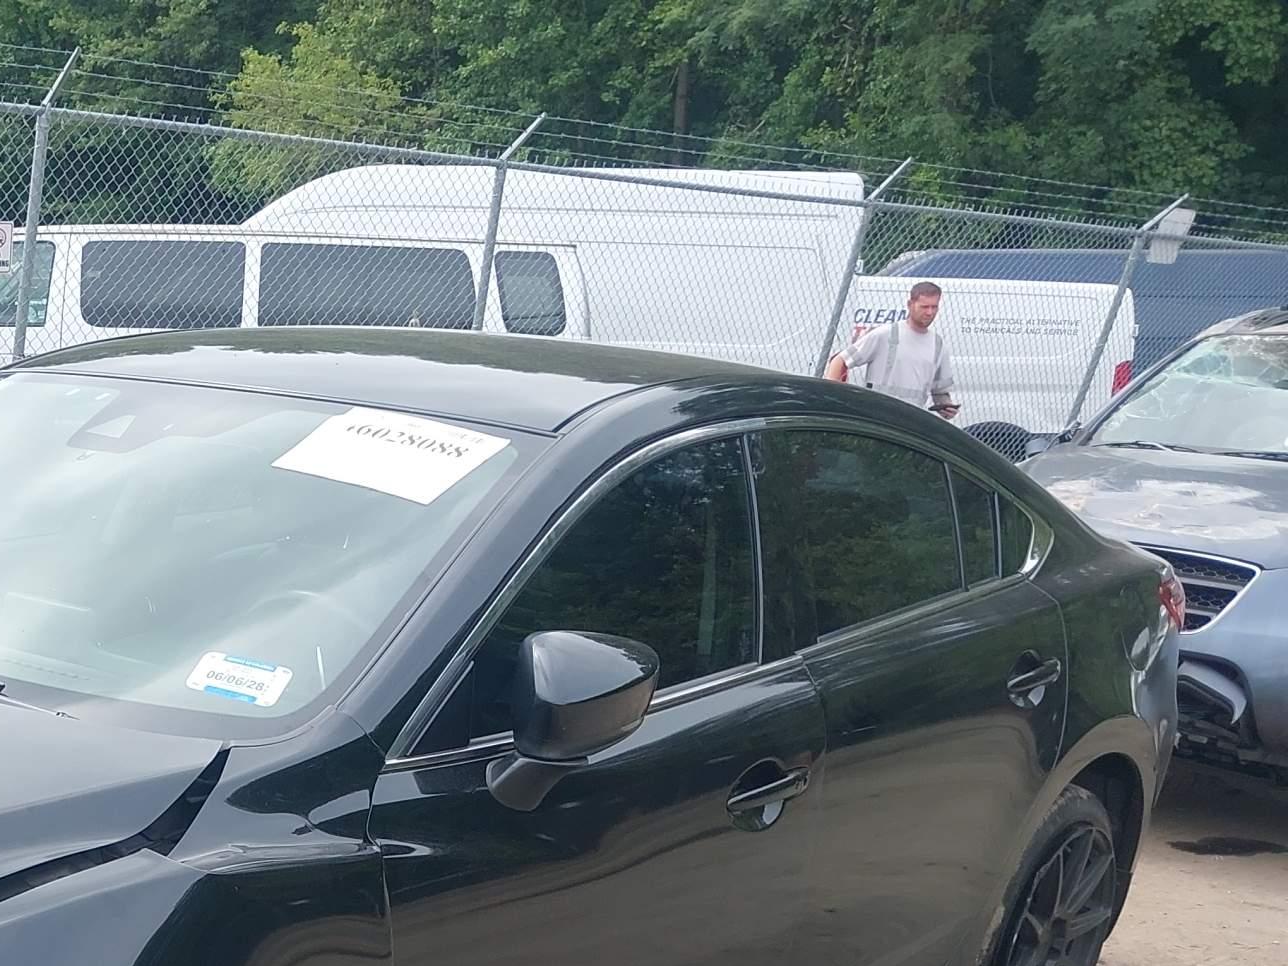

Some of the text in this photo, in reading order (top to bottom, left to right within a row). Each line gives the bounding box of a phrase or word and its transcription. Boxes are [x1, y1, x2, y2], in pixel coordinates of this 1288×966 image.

[961, 317, 1080, 327] THE PRACTICAL ALTERNATIVE
[973, 326, 1023, 335] CHEMICALS
[1025, 327, 1041, 335] AND
[1043, 328, 1079, 336] SERVICE
[206, 670, 265, 691] 06/06/28
